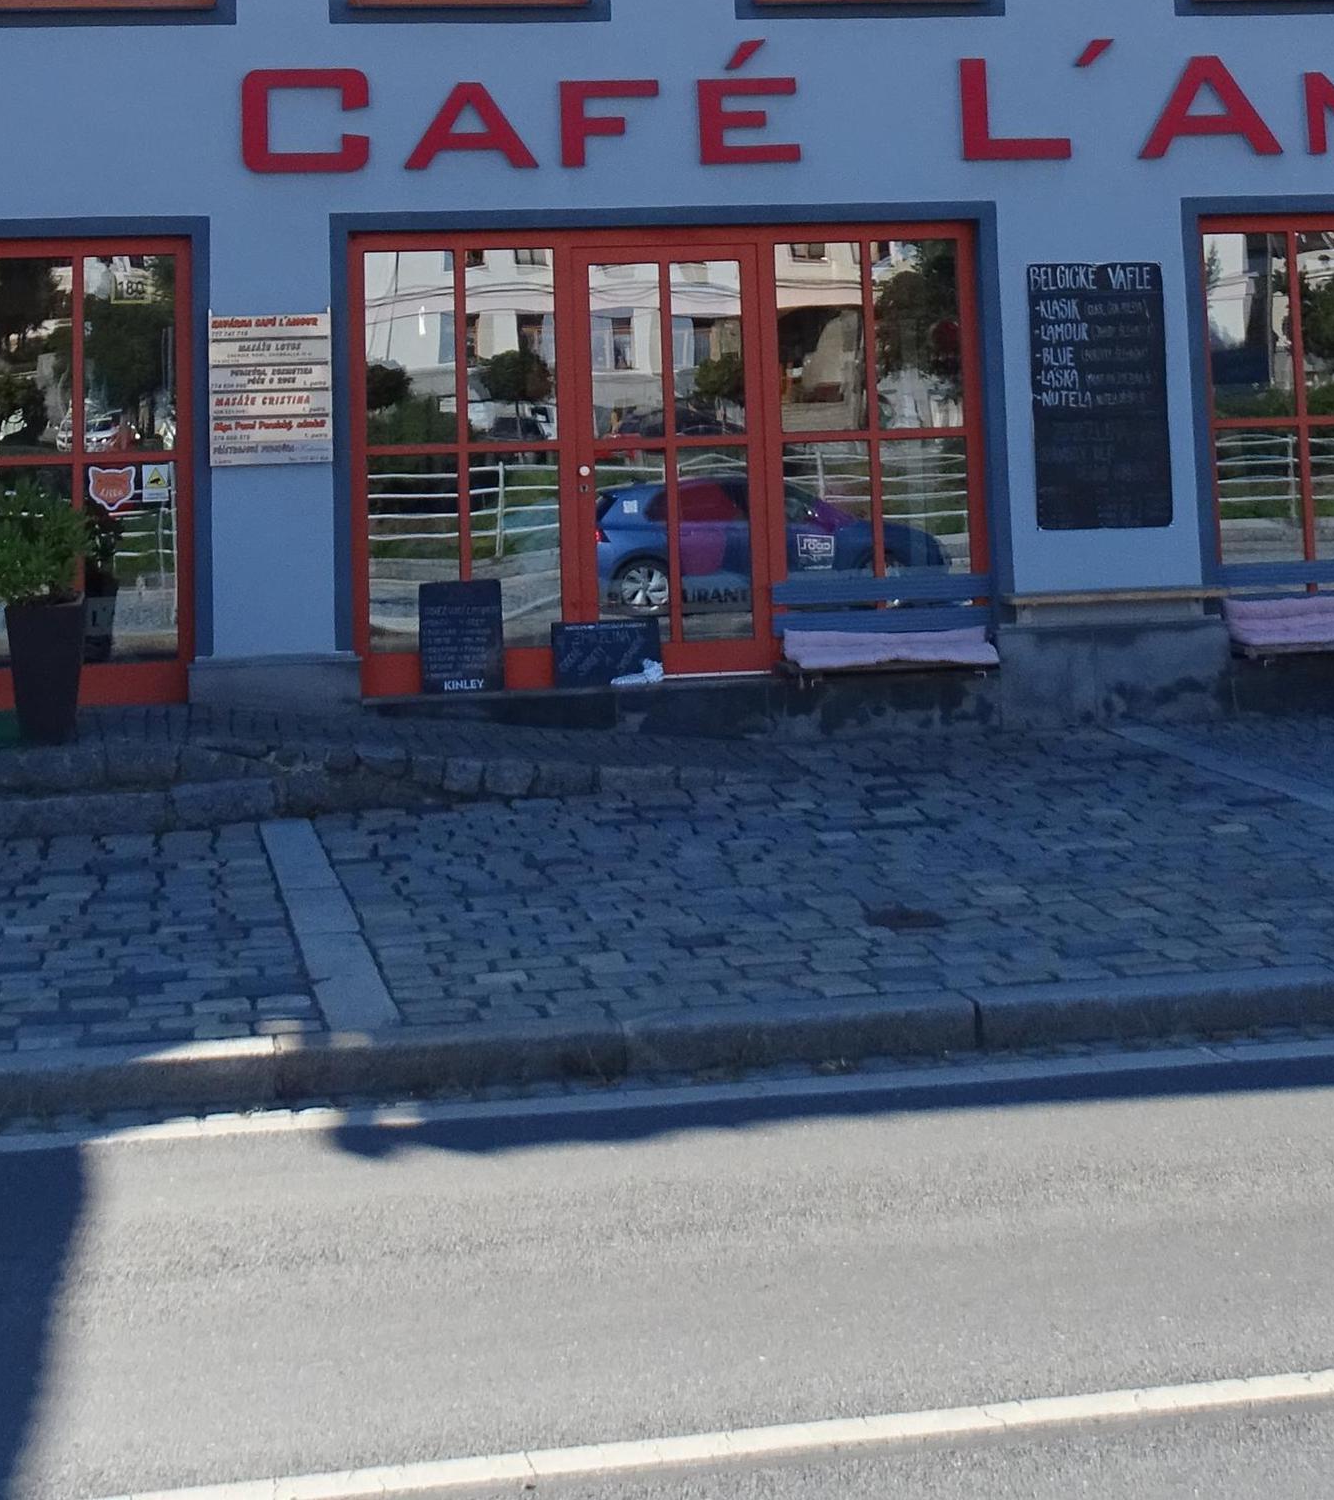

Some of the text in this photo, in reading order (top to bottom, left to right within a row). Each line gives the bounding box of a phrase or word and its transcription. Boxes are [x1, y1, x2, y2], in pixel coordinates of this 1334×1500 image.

[240, 39, 801, 174] CAFÉ
[1107, 264, 1152, 290] VAFLE
[117, 280, 145, 296] 180
[215, 395, 311, 406] MASÁŽE CRISTINA
[444, 679, 484, 691] KINLEY
